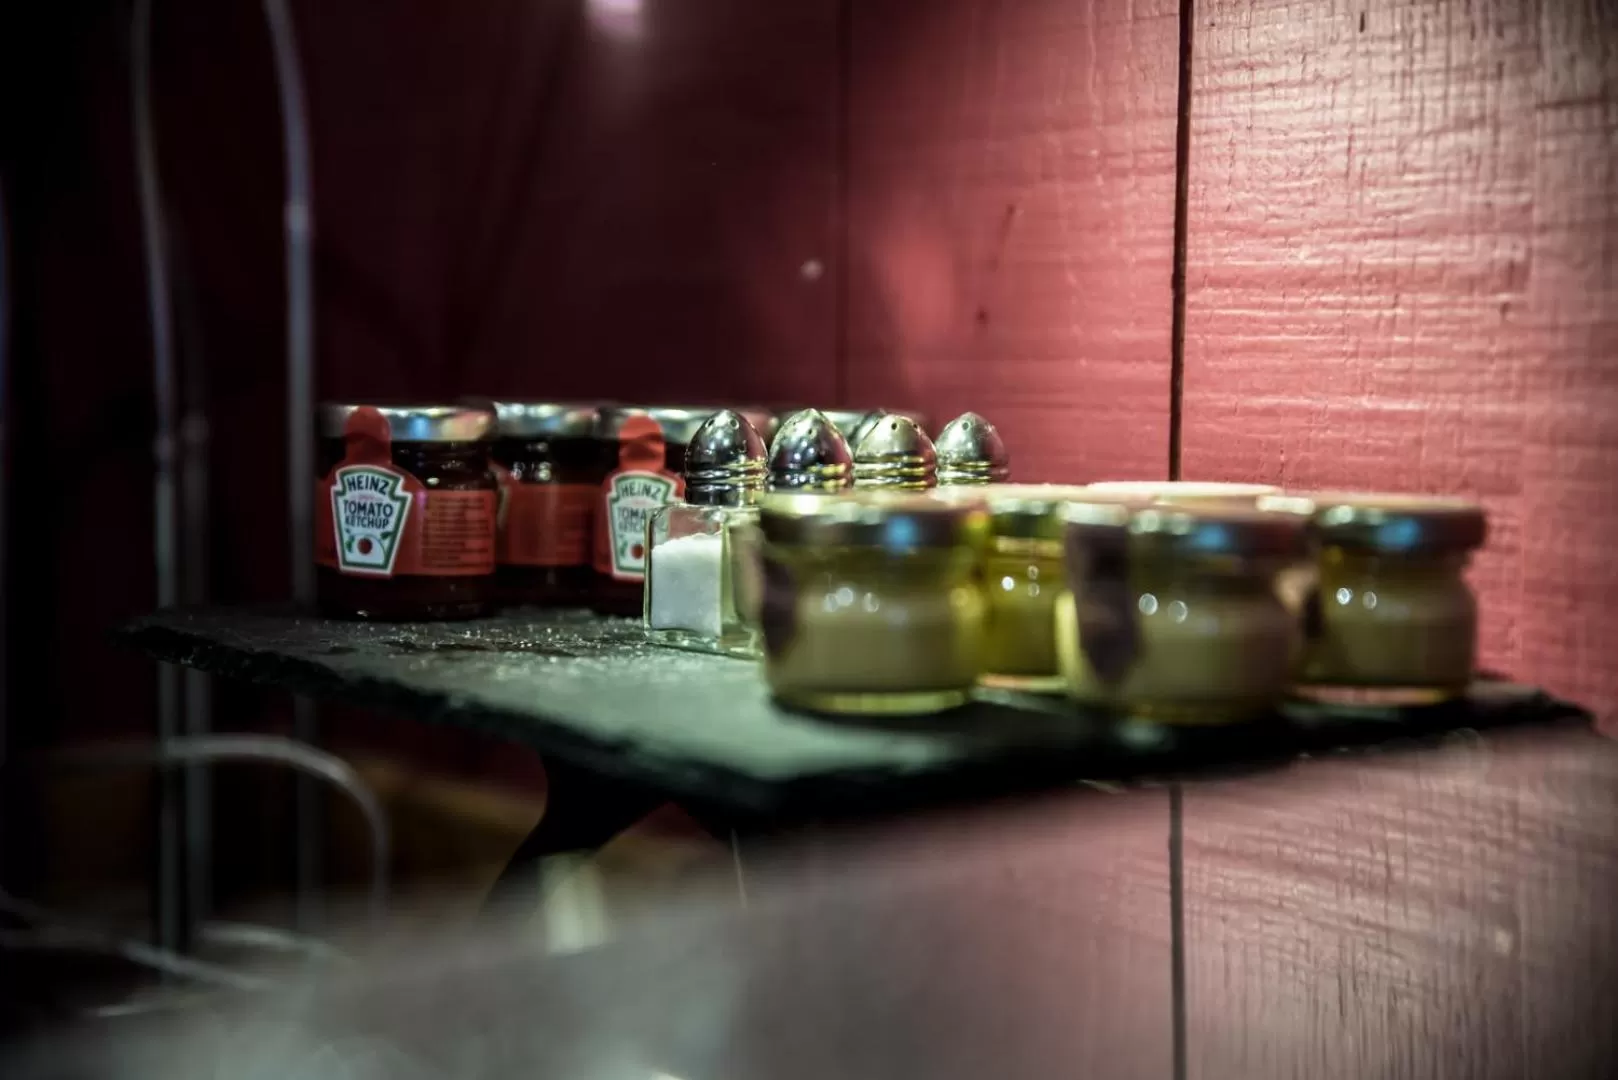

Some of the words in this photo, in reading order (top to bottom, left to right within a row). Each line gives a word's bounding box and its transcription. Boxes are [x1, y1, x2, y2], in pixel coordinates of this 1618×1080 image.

[347, 475, 390, 495] HEINZ
[621, 483, 661, 500] HEINZ
[343, 500, 393, 518] TOMATO
[345, 515, 389, 530] KETCHUP
